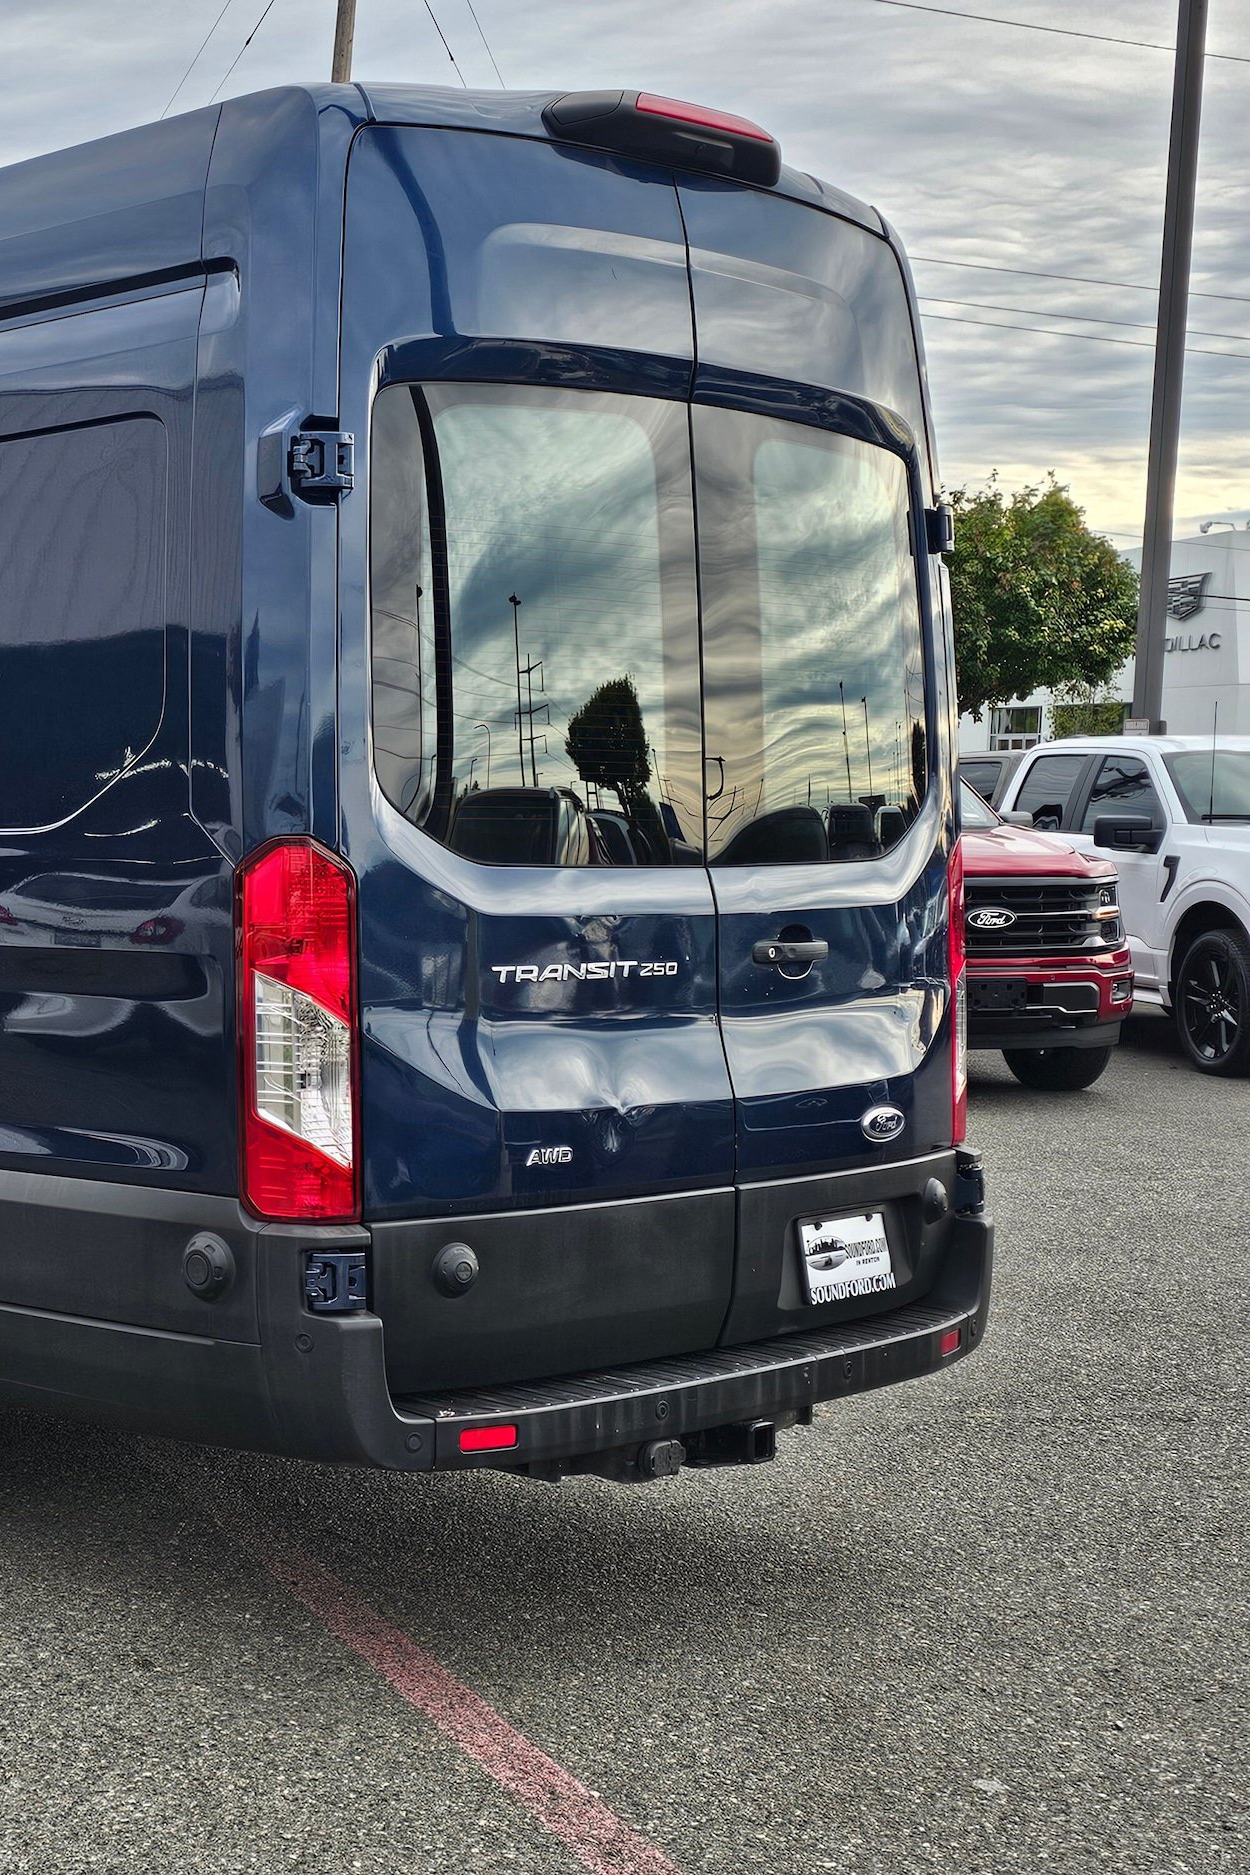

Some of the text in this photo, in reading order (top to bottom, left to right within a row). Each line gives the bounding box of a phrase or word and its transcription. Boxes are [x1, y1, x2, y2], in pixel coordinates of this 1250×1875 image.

[1165, 633, 1221, 652] DILLAC
[976, 912, 1007, 926] Ford
[491, 960, 679, 984] TRANSIT 250
[525, 1146, 574, 1167] AWD
[811, 1273, 896, 1305] SOUNDFORD.COM
